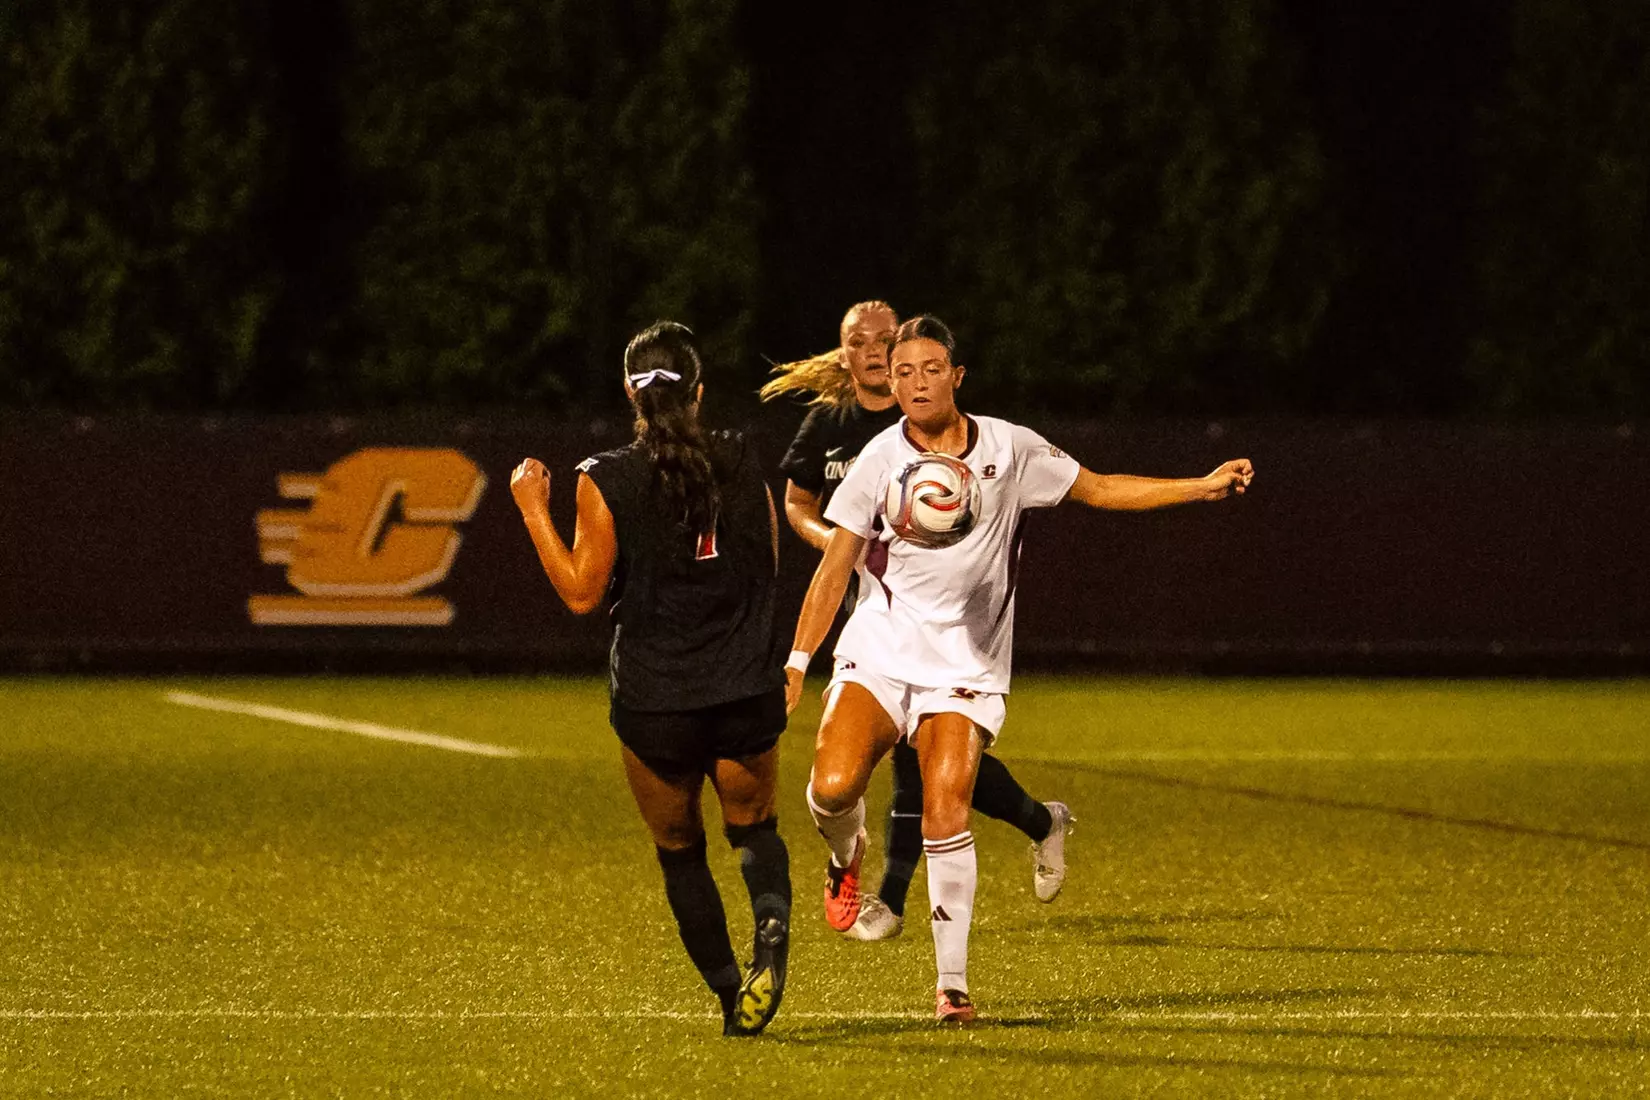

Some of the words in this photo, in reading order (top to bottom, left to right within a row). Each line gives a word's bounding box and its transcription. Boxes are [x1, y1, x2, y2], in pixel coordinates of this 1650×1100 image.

[825, 461, 852, 479] CIN
[981, 464, 996, 478] C
[256, 447, 488, 598] C
